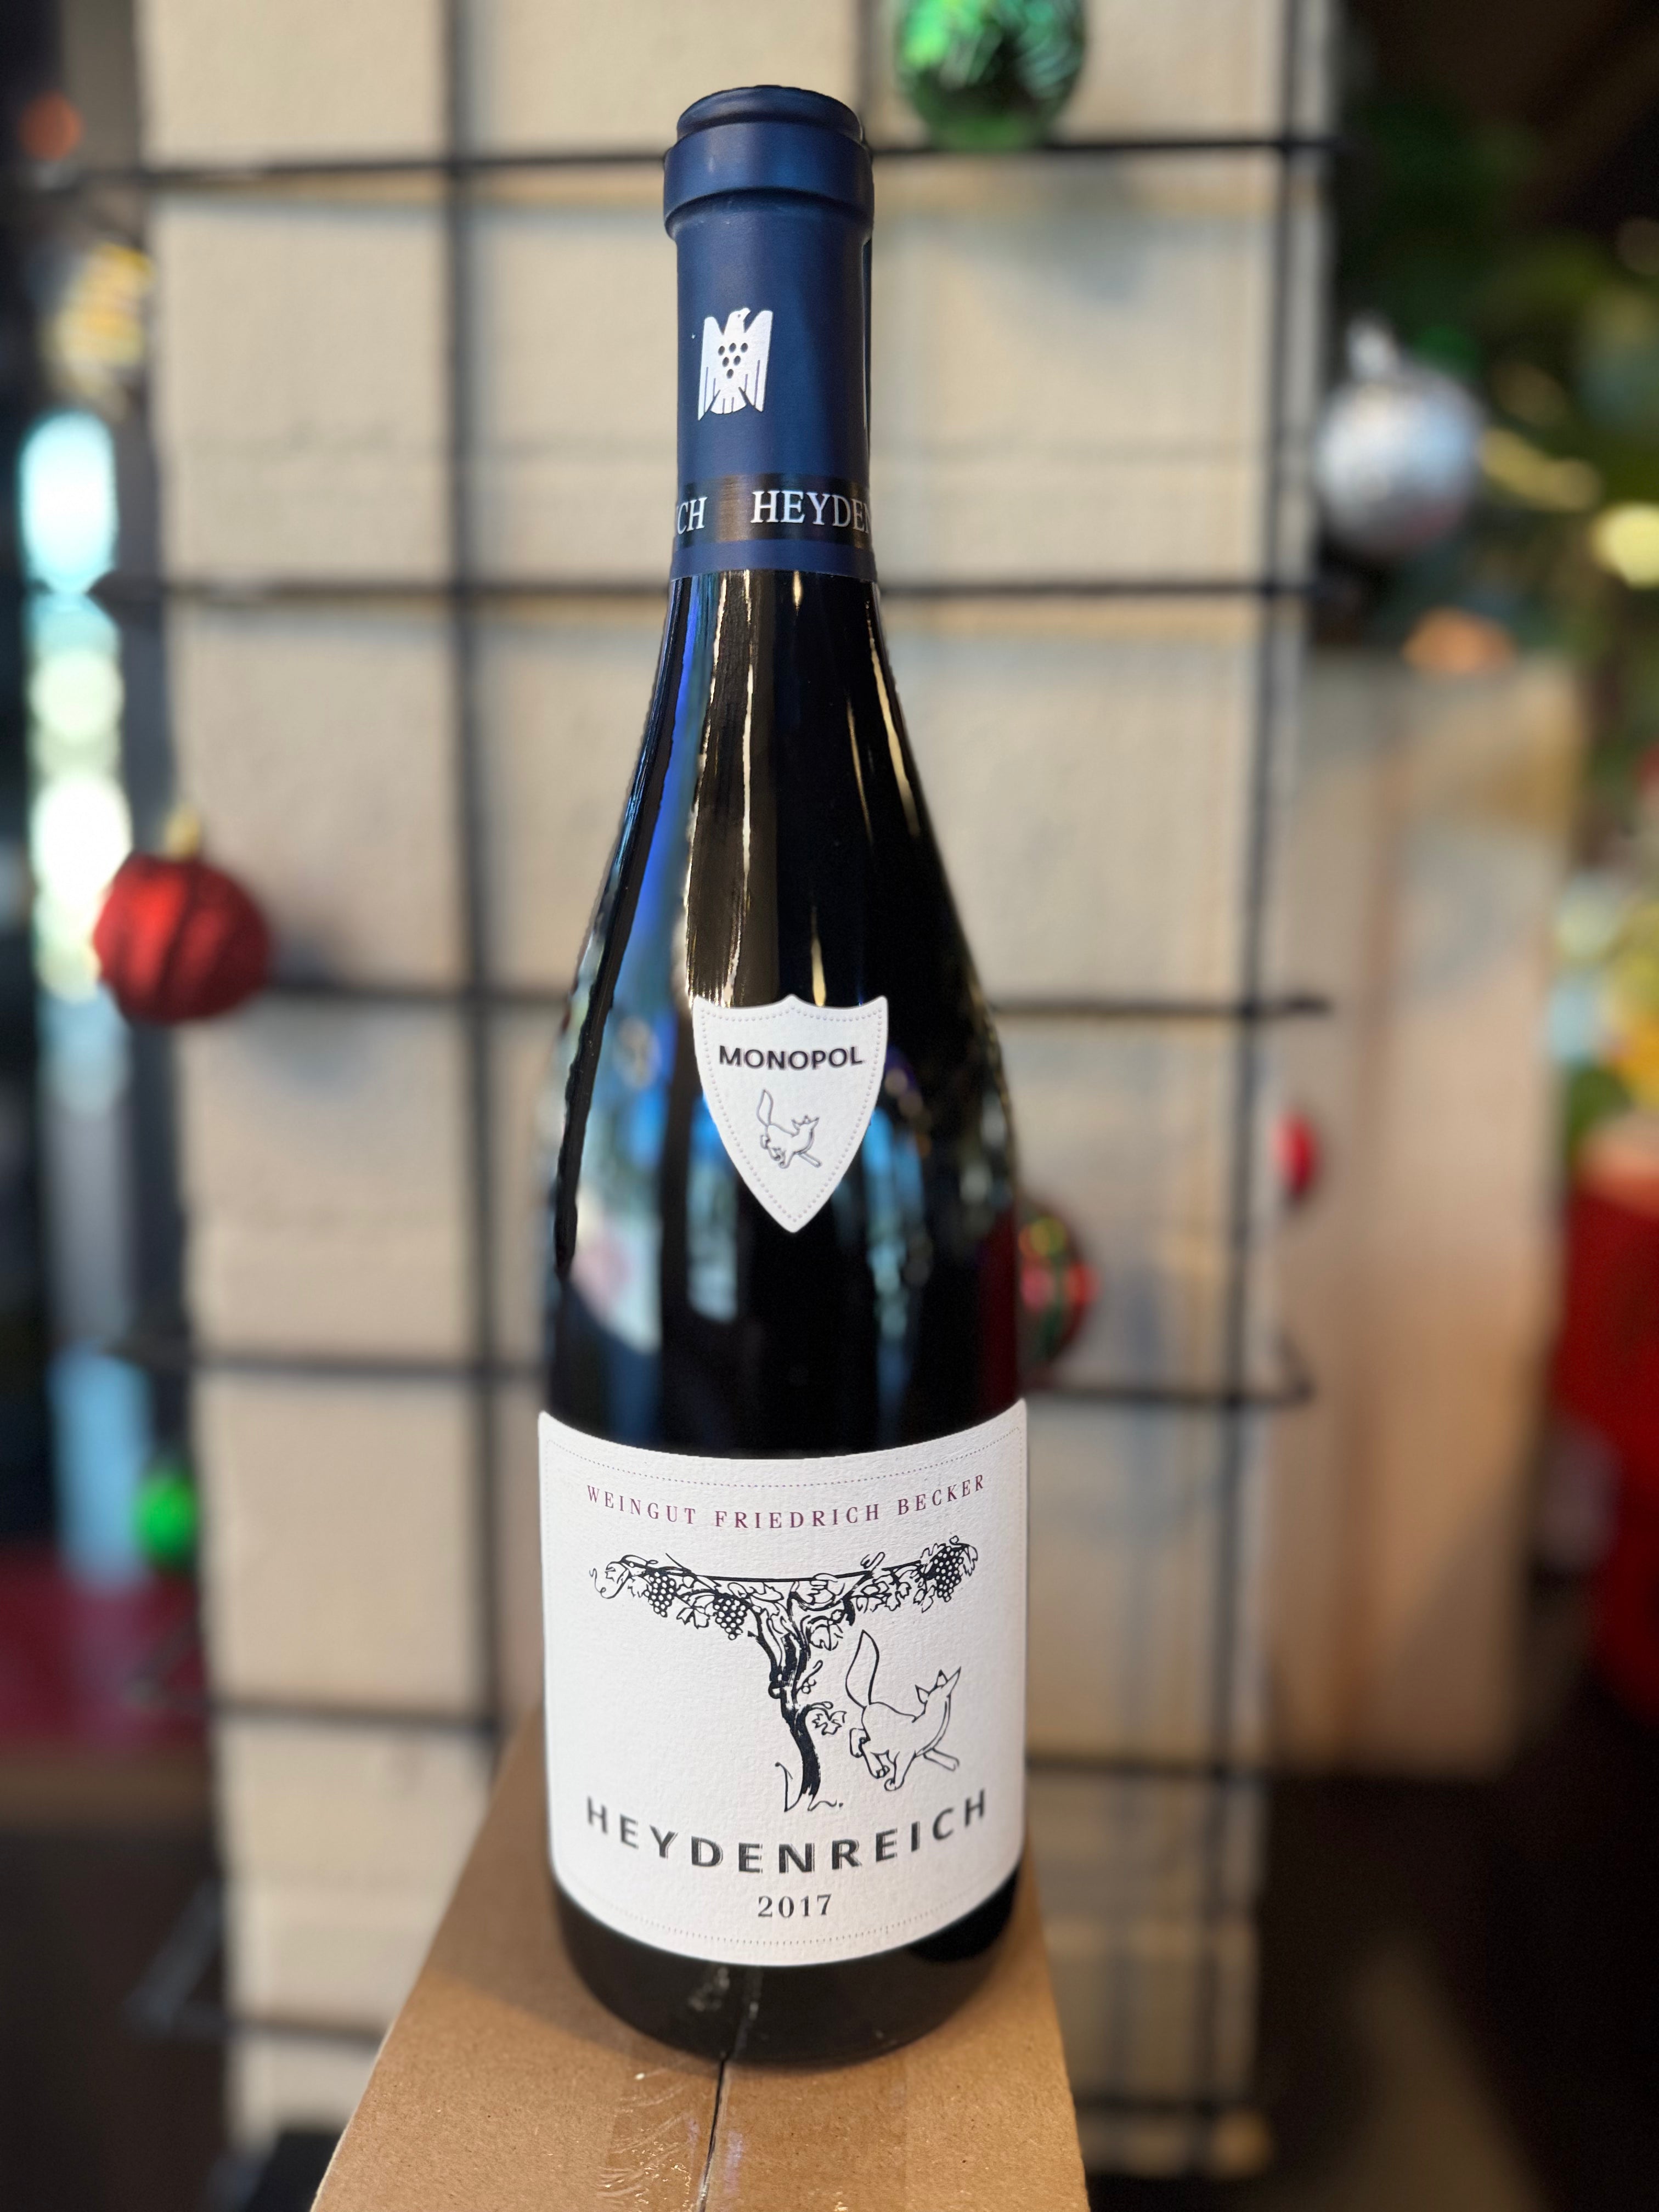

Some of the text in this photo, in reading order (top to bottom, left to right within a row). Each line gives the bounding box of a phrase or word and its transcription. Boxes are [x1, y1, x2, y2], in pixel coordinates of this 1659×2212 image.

[676, 496, 708, 534] CH
[719, 1045, 864, 1070] MONOPOL
[586, 1474, 984, 1529] WEINGUT FRIEDRICH BECKER
[586, 1789, 986, 1874] HEYDENREICH
[757, 1894, 833, 1918] 2017
